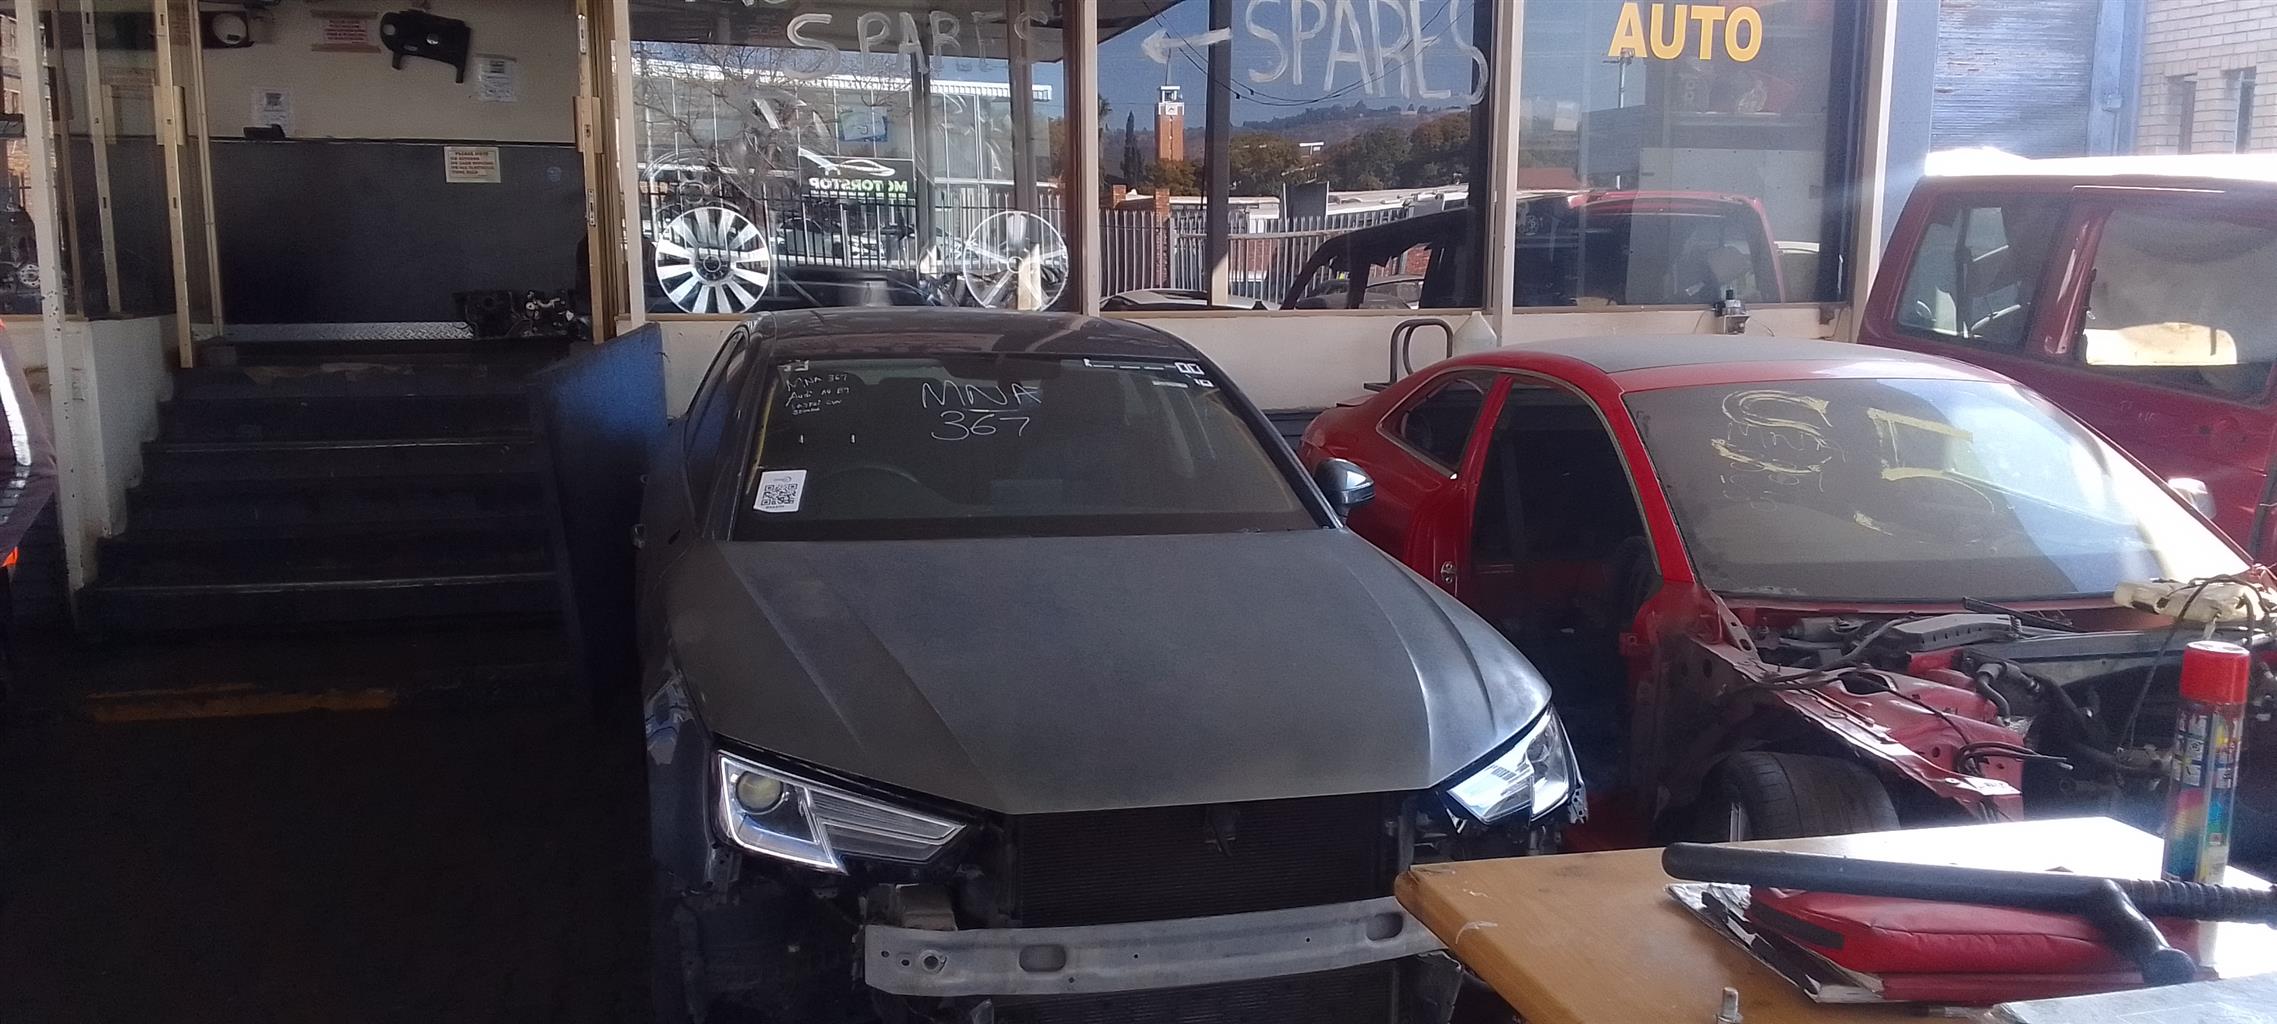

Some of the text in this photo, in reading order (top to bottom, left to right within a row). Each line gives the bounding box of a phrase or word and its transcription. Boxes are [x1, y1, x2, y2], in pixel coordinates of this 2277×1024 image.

[1244, 0, 1489, 105] SPARES
[1608, 1, 1763, 63] AUTO
[921, 380, 1042, 410] MNA
[931, 410, 1031, 442] 367
